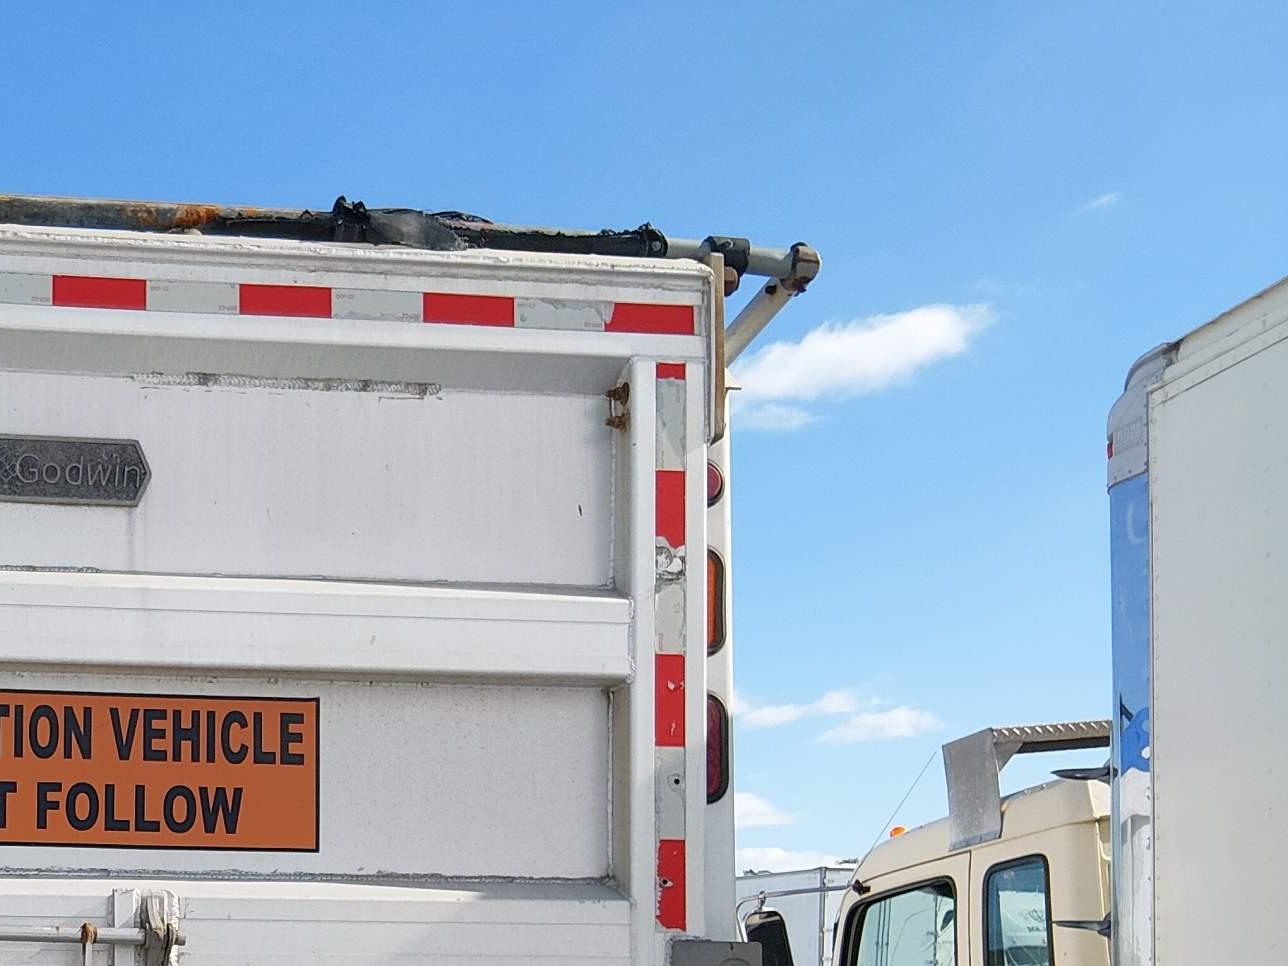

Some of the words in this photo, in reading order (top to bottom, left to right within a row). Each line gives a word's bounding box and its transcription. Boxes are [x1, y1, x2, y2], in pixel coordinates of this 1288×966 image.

[15, 452, 142, 489] Godwin
[109, 706, 306, 766] VEHICLE
[36, 781, 244, 835] FOLLOW
